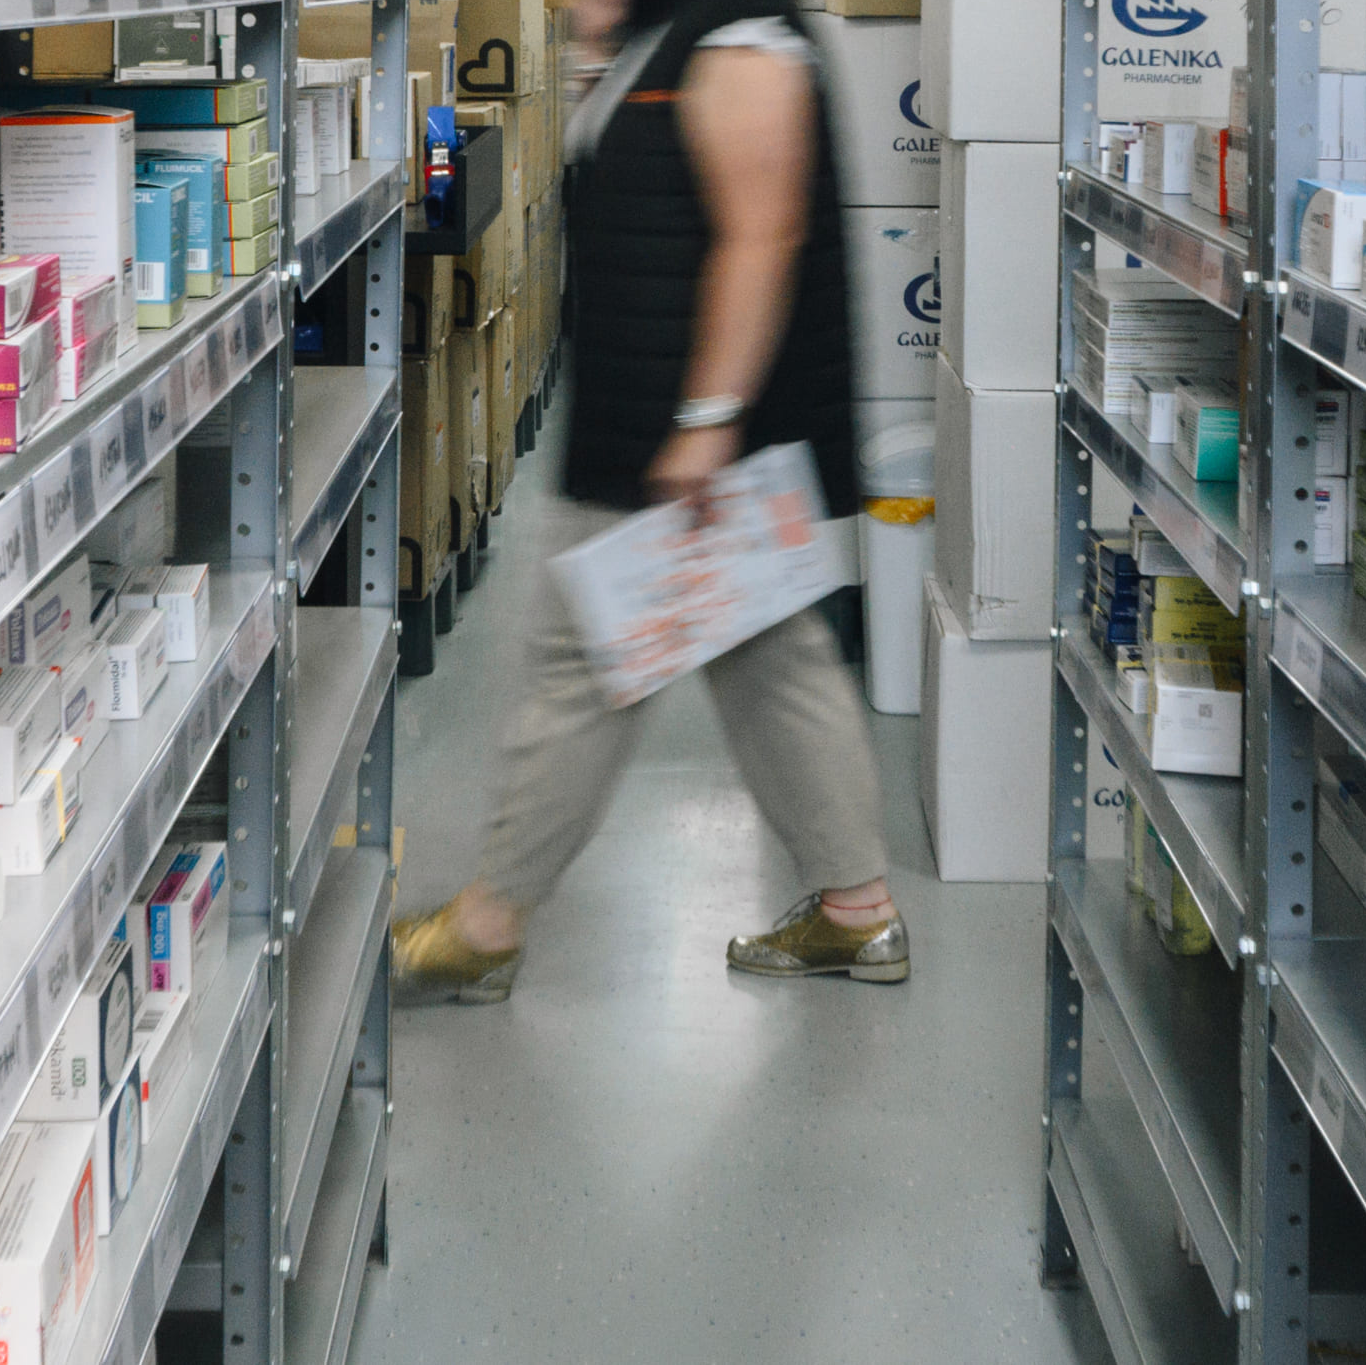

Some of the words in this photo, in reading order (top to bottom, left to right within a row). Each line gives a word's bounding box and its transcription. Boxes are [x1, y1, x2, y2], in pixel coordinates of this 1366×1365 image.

[1102, 48, 1223, 68] GALENIKA
[1124, 73, 1203, 85] PHARMACHEM
[155, 164, 205, 173] FLUIMUCIL
